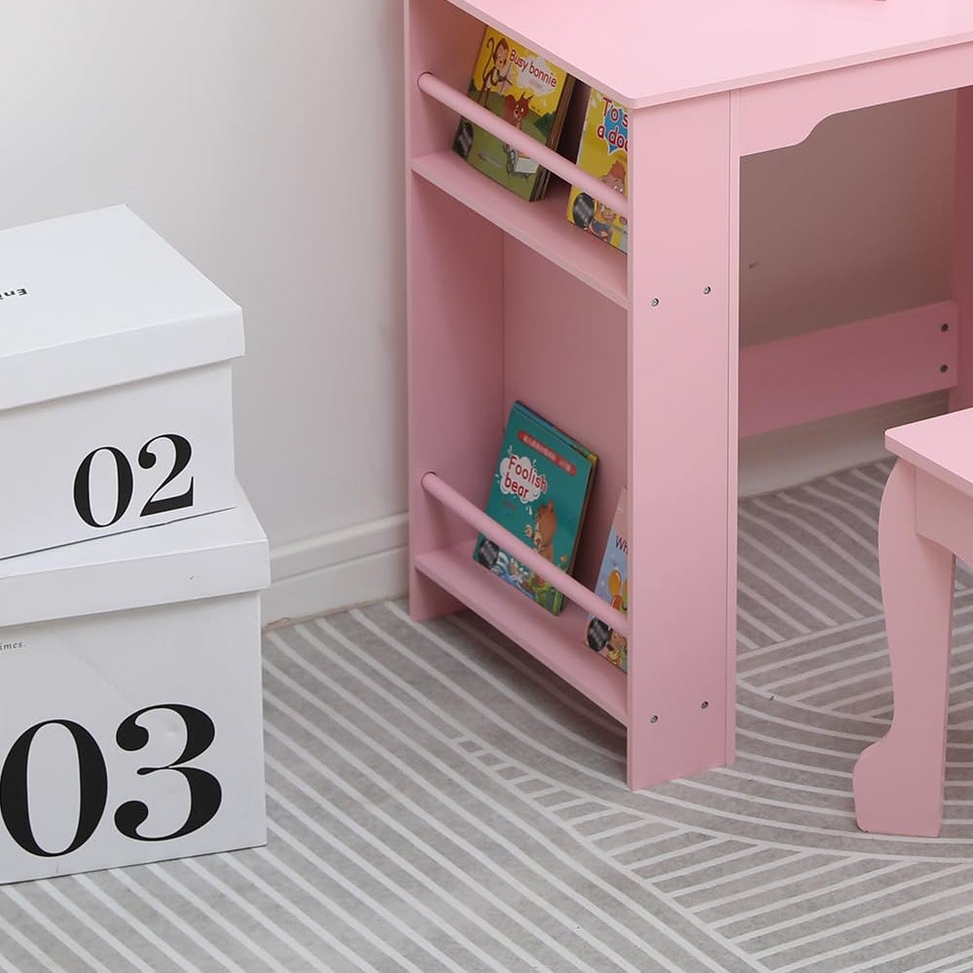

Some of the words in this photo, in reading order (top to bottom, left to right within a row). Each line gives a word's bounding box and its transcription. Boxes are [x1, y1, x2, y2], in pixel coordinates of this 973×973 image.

[509, 49, 528, 72] Busy
[529, 61, 557, 87] bonnie
[603, 97, 619, 121] To
[597, 125, 605, 139] a
[73, 433, 194, 528] 02
[505, 472, 529, 498] bear
[508, 455, 547, 490] Foolish
[0, 703, 222, 857] 03
